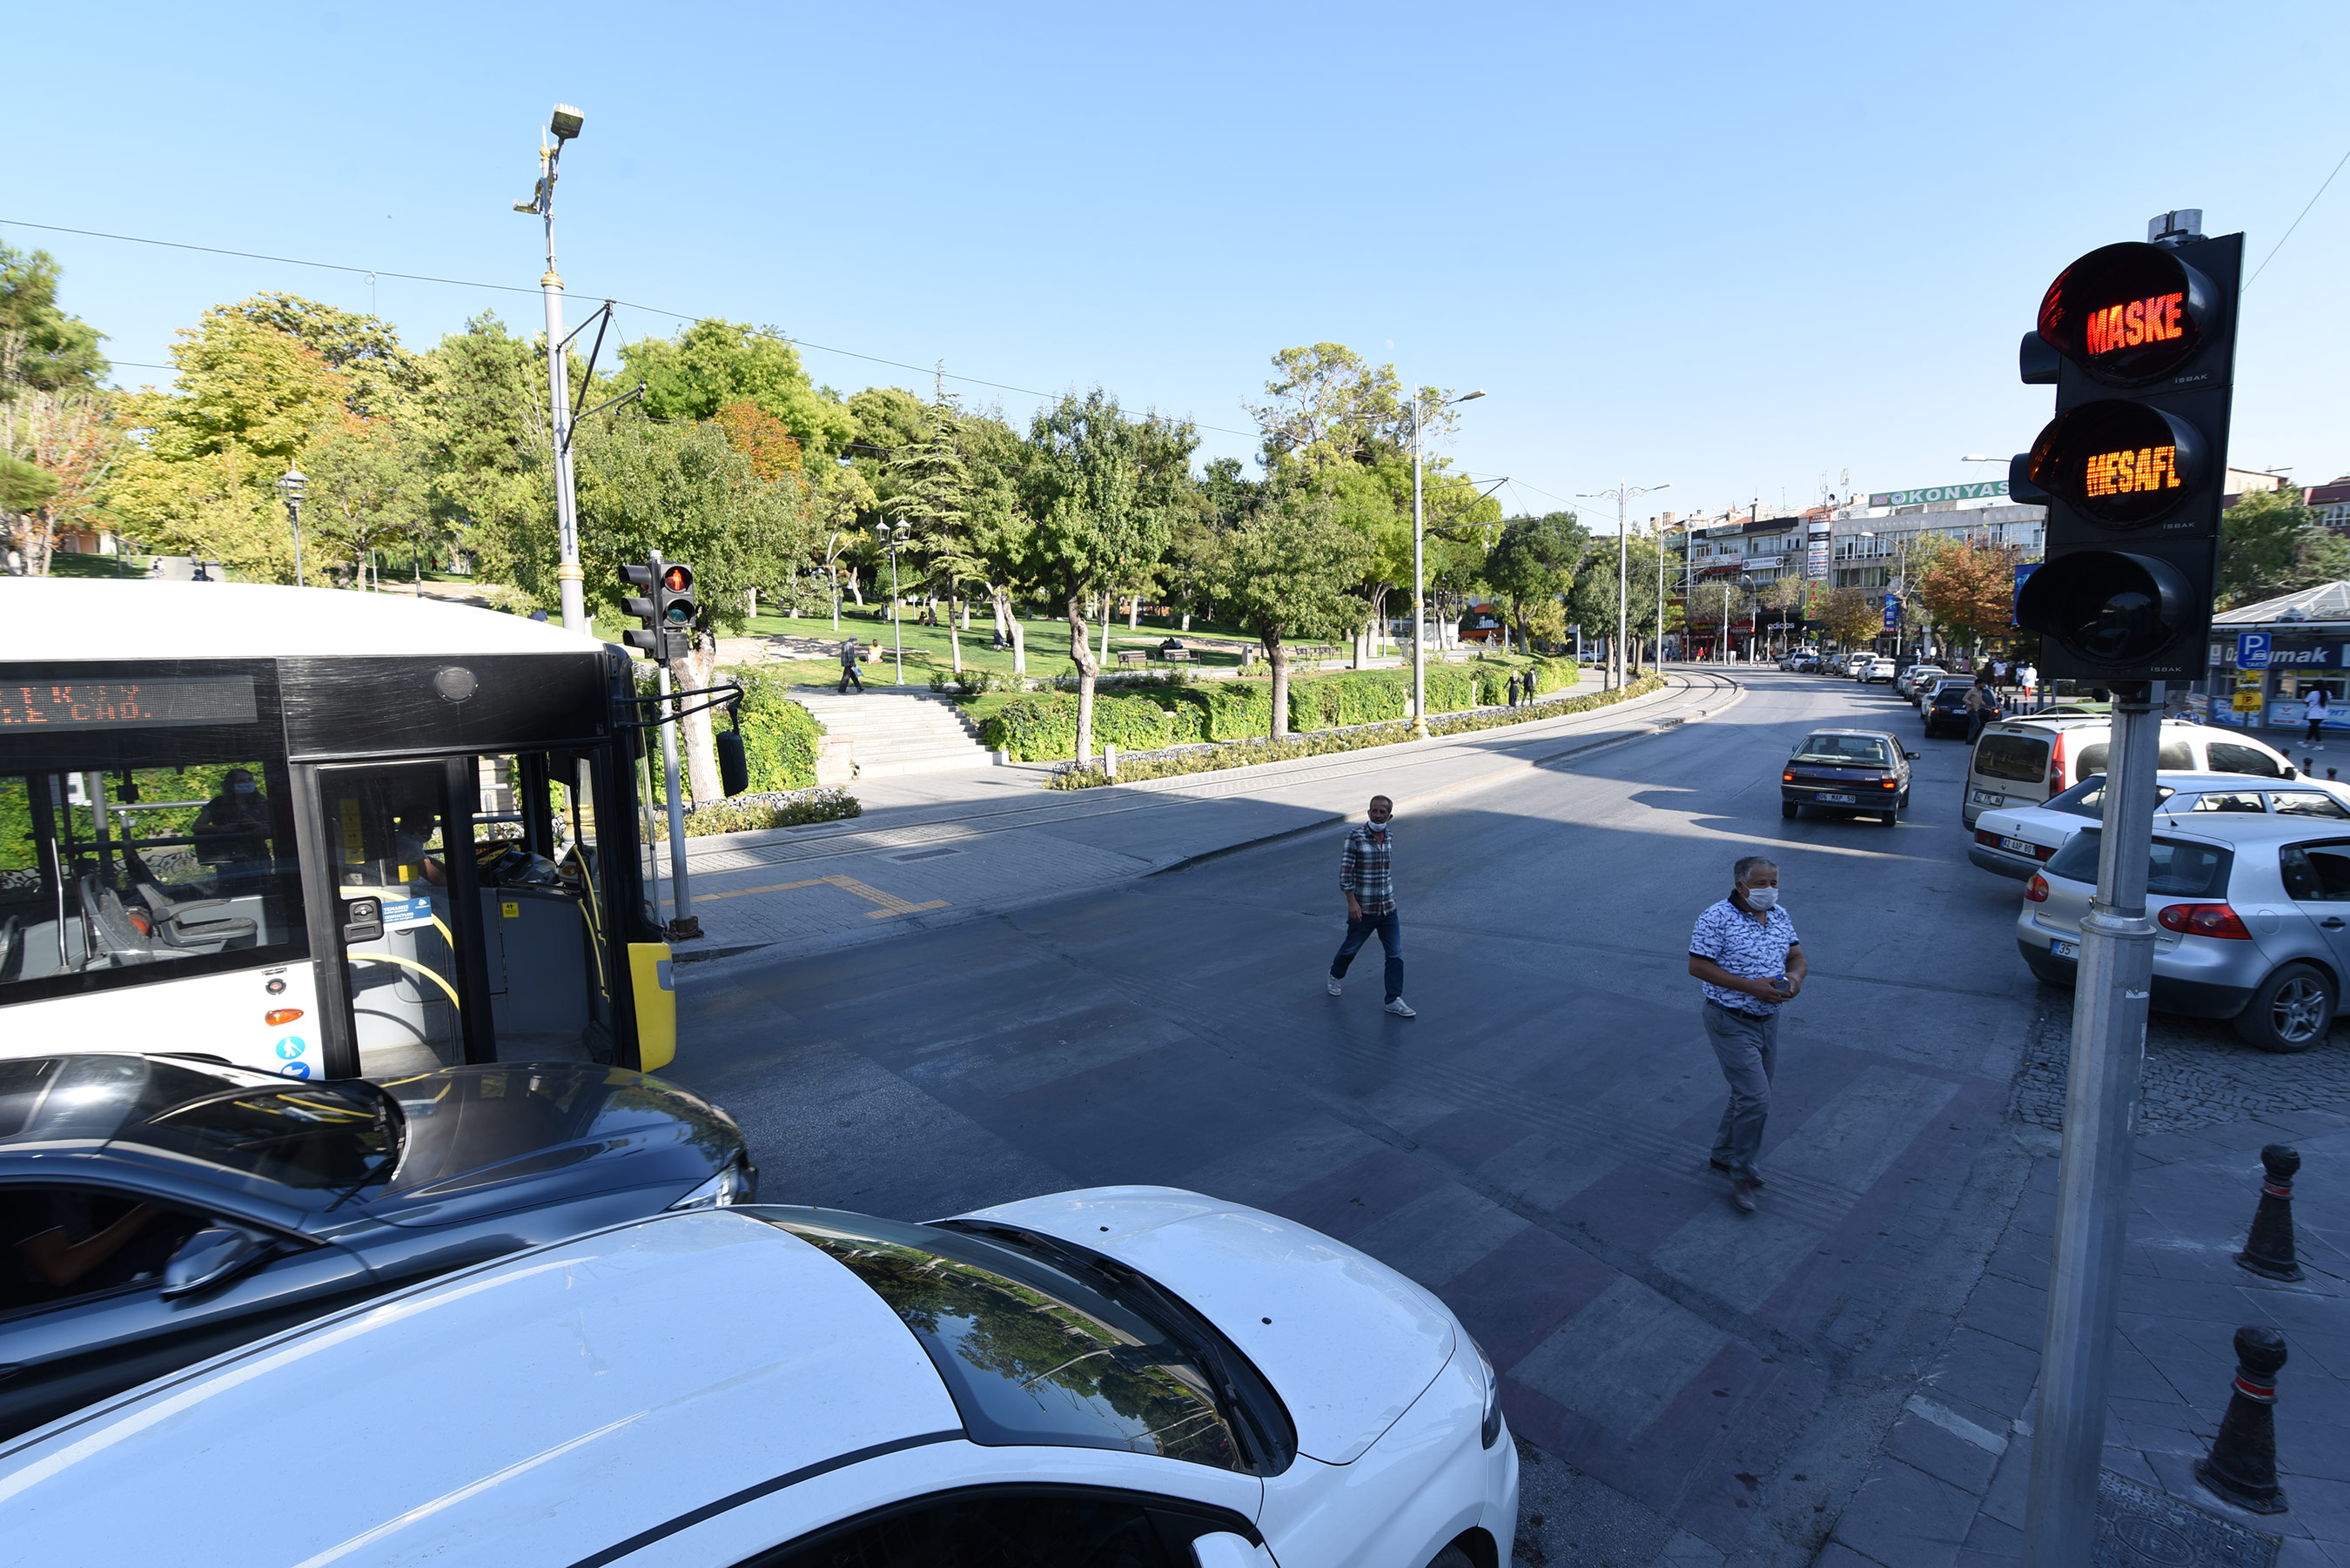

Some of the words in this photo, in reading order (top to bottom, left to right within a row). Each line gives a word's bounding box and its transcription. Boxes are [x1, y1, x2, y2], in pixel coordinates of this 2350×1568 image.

[2086, 292, 2183, 355] MASKE
[2245, 635, 2263, 655] P
[2058, 943, 2071, 955] 35
